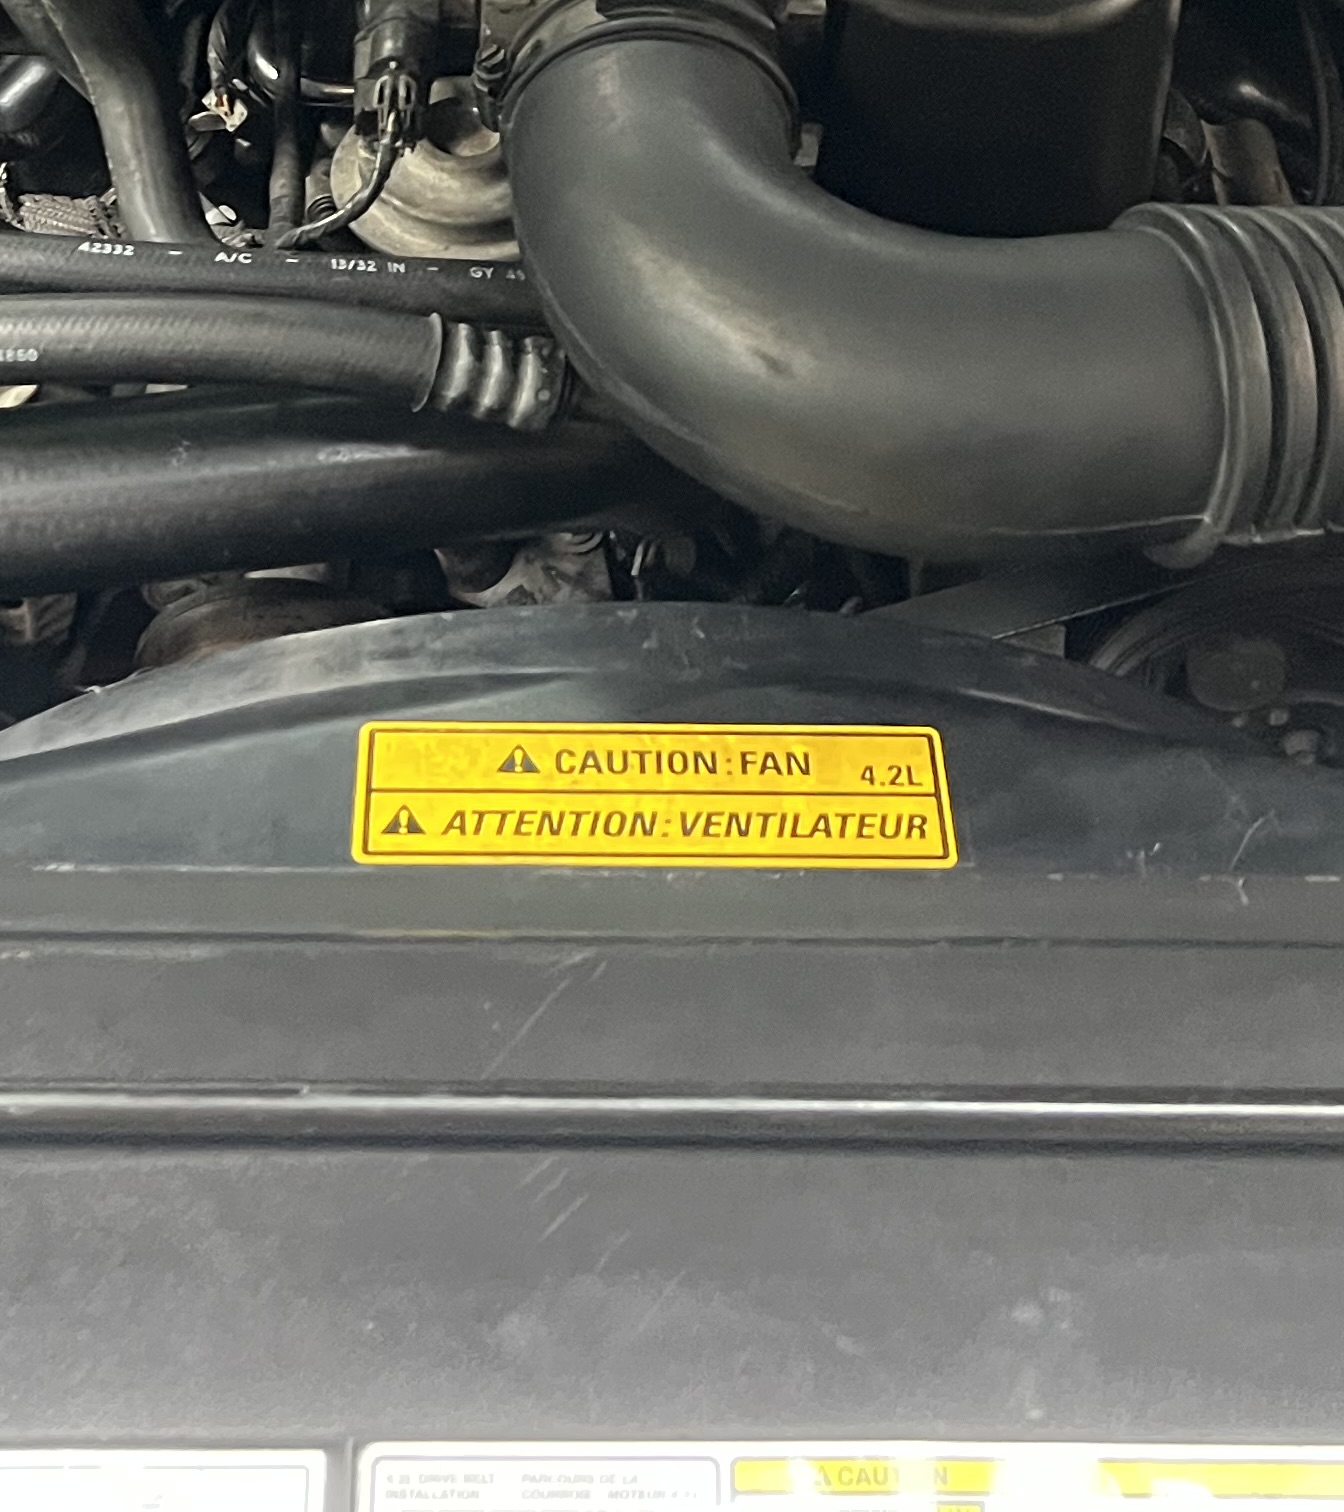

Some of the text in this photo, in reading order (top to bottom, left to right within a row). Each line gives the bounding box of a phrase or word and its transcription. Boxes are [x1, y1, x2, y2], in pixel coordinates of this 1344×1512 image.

[78, 241, 135, 256] 42332
[214, 251, 252, 264] A/C
[331, 258, 378, 272] 13/32
[387, 262, 406, 273] IN
[469, 267, 494, 279] GY
[860, 764, 924, 787] 4.2L
